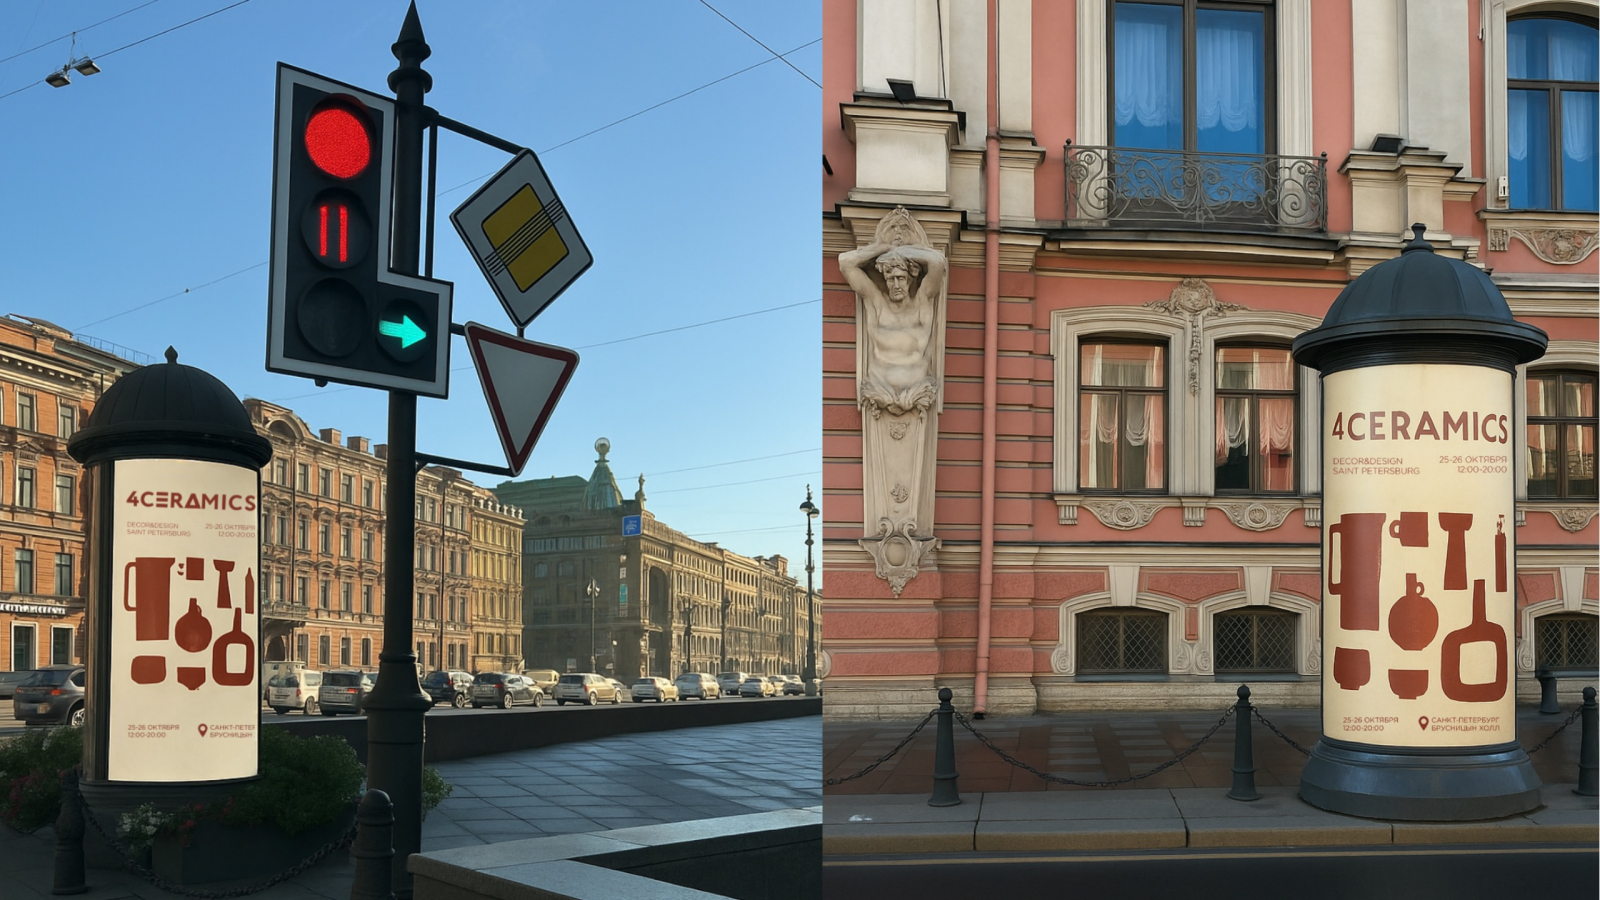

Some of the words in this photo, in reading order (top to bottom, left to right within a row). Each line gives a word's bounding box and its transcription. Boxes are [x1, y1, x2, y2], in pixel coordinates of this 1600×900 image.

[1332, 410, 1508, 444] 4CERAMICS
[1332, 457, 1403, 465] DECOR&DESIGN
[1332, 467, 1359, 475] SAINT
[1361, 467, 1420, 475] PETERSBURG
[126, 490, 256, 511] 4CERAMICS
[126, 521, 179, 529] DECOR&DESIGN
[1431, 724, 1477, 732] БРУСНИЦЫН
